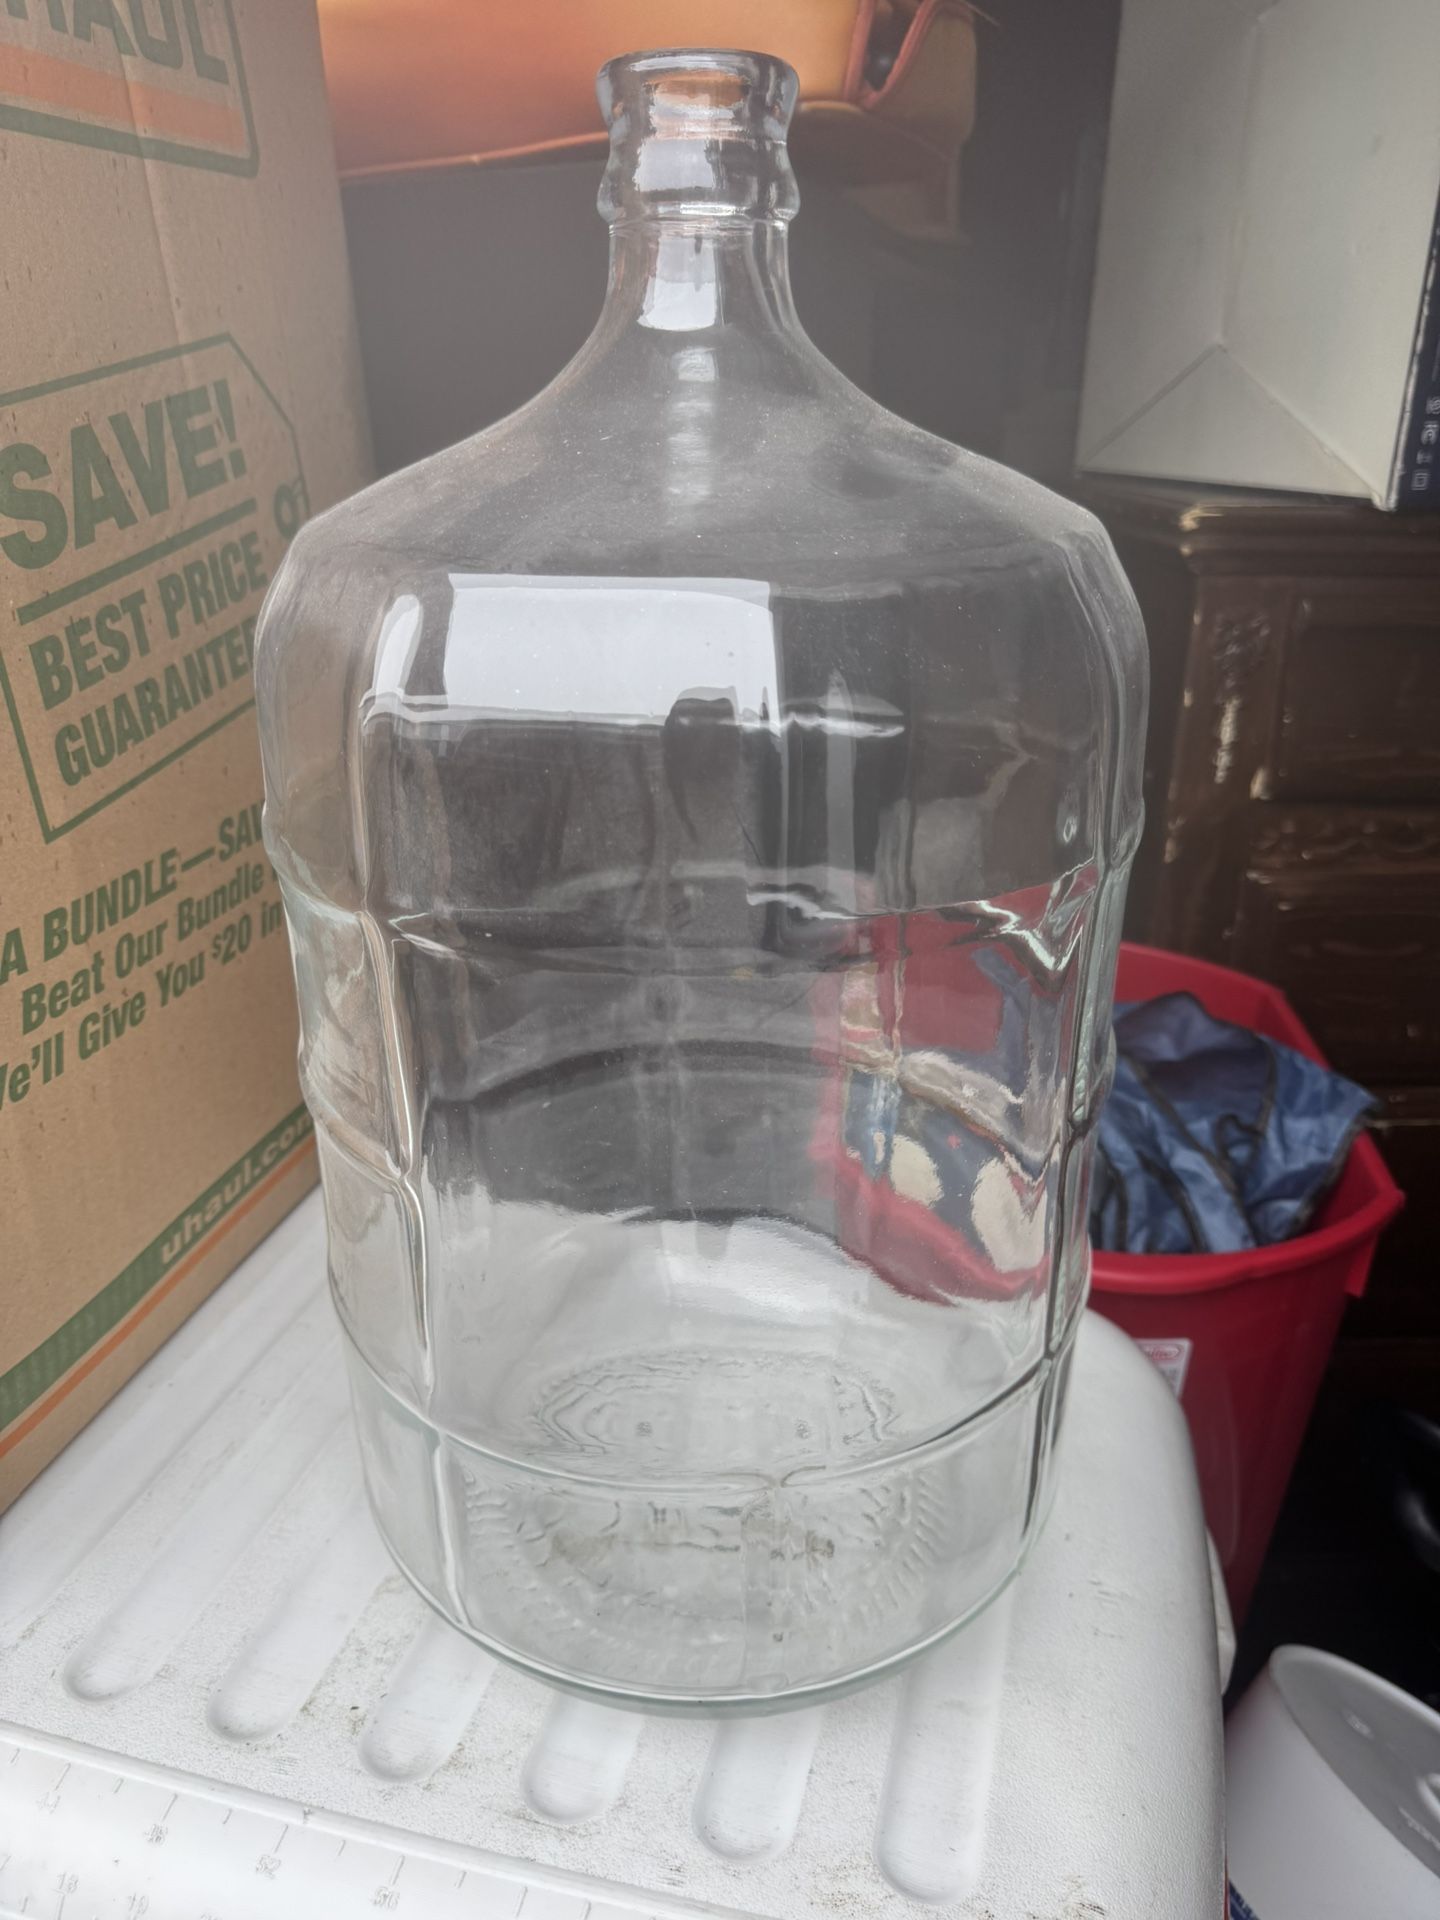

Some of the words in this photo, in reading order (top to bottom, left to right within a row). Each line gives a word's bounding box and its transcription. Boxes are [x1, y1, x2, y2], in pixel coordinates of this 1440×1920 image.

[0, 378, 247, 570] SAVE!
[28, 586, 151, 711] BEST
[157, 531, 269, 640] PRICE
[0, 927, 29, 986] A
[0, 1030, 65, 1111] e'll
[78, 990, 146, 1060] Give
[155, 951, 205, 1008] You
[211, 914, 252, 965] $20
[21, 950, 105, 1036] Beat
[114, 920, 168, 979] Our
[177, 862, 264, 942] Bundle
